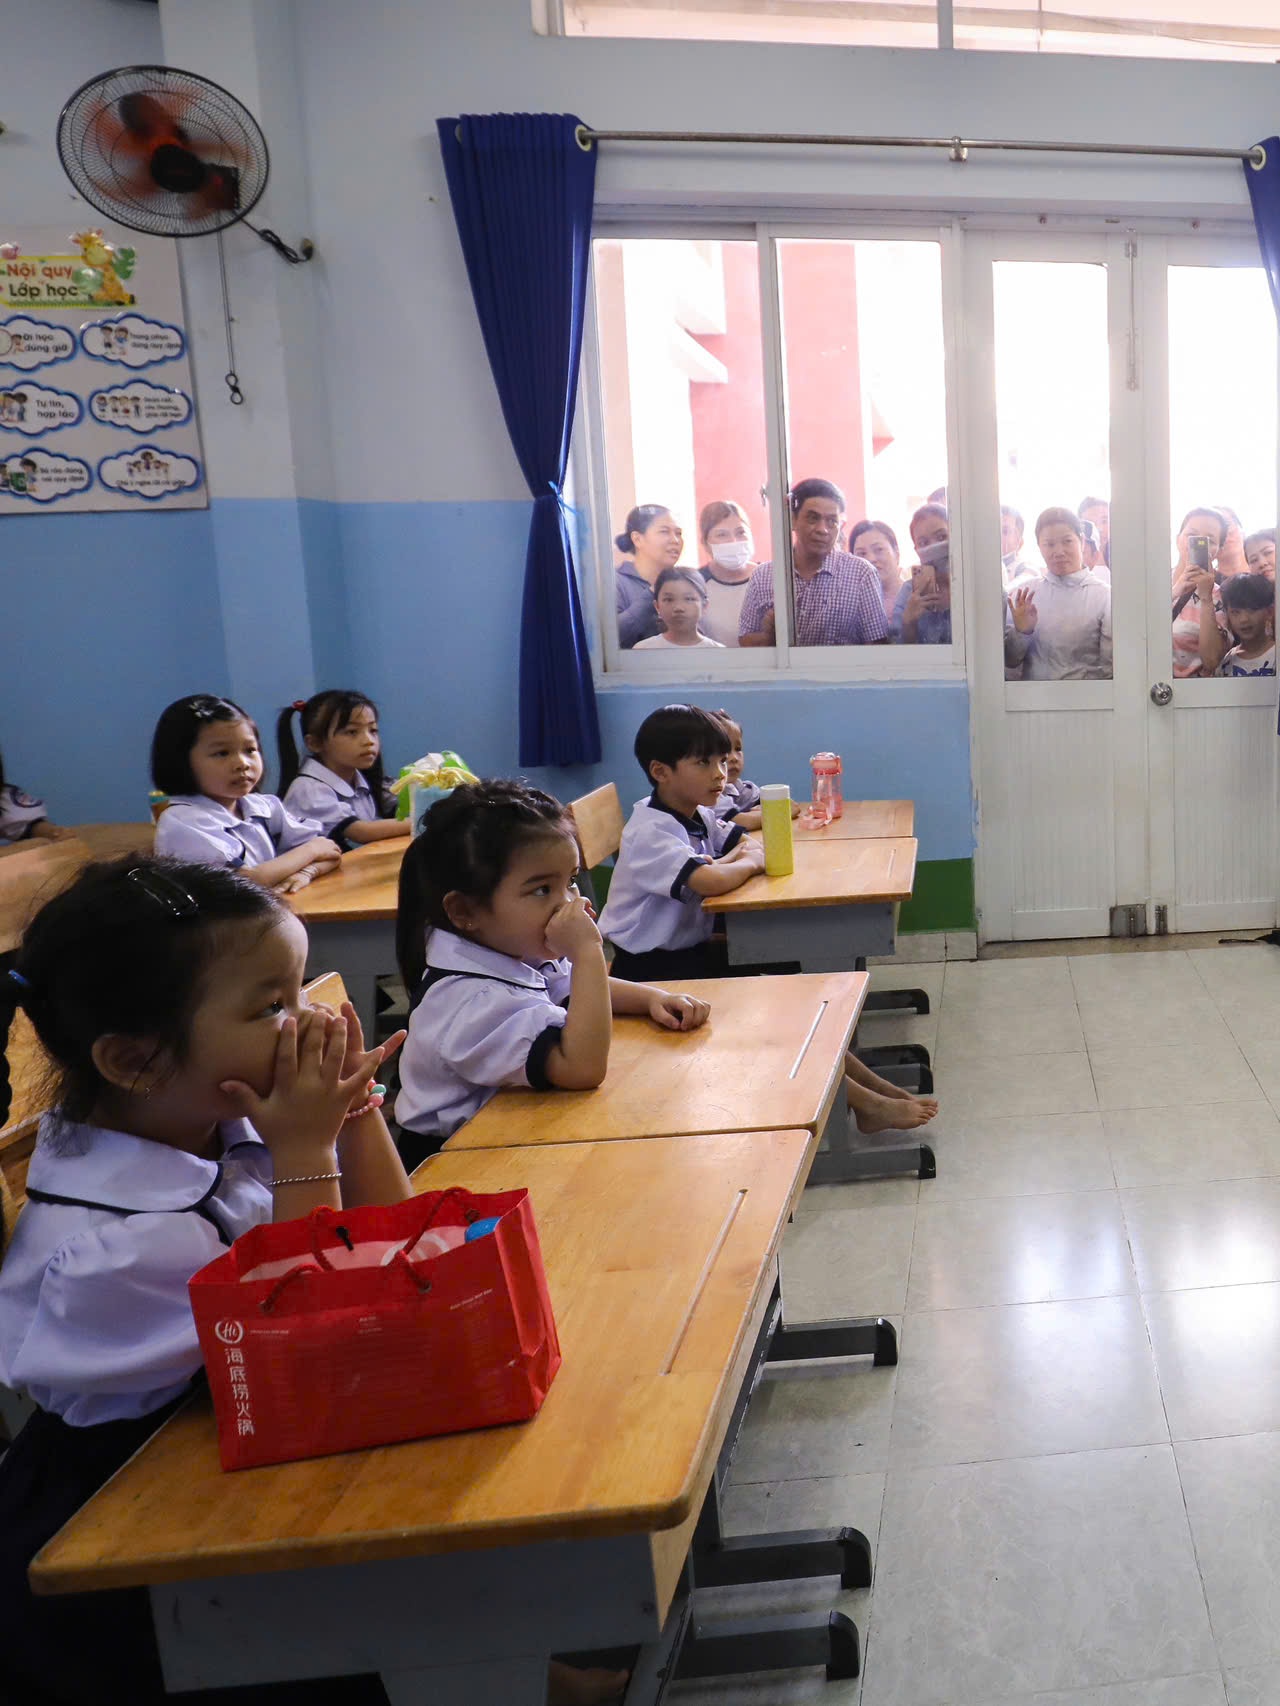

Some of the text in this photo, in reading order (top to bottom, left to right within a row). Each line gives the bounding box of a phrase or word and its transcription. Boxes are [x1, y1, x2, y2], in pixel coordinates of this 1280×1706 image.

[7, 262, 73, 280] Nội quy
[9, 282, 79, 300] Lớp học
[225, 1347, 255, 1436] 海底捞火锅
